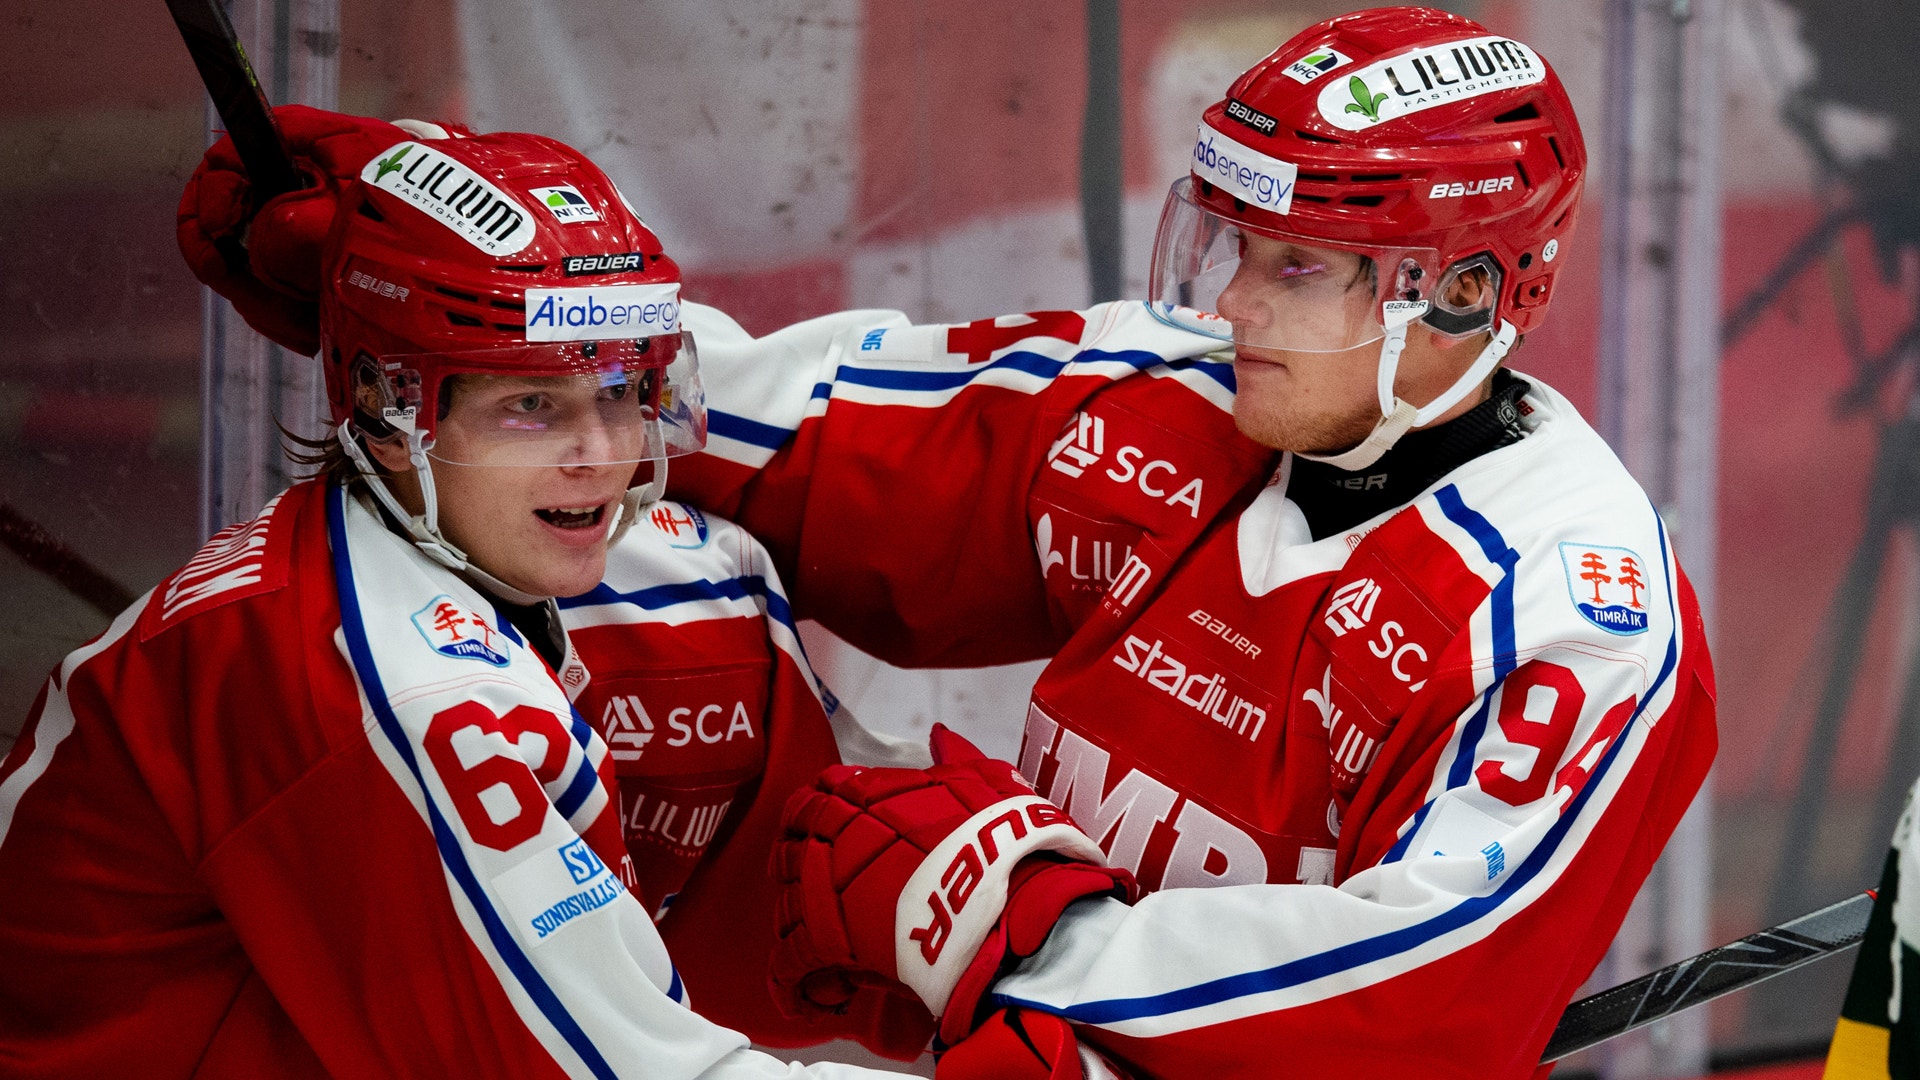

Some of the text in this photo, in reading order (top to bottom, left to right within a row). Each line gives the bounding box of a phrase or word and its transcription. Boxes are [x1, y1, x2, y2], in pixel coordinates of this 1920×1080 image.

[1291, 62, 1319, 81] NHC
[1385, 40, 1533, 97] LILIUM
[1403, 72, 1537, 108] FASTIGHETER
[1228, 100, 1277, 134] BAUER
[403, 153, 524, 242] LILIUM
[1429, 176, 1515, 200] BAUER
[395, 183, 497, 251] FASTIGHETER
[568, 255, 640, 272] BAUER
[348, 270, 411, 303] BAUER
[1386, 301, 1427, 310] BAUER
[385, 408, 415, 417] BAUER
[1105, 446, 1204, 519] SCA
[1188, 609, 1262, 661] BAUER
[1592, 607, 1643, 628] TIMRÅ IK
[1112, 634, 1267, 743] stadium
[666, 701, 755, 747] SCA
[909, 803, 1089, 966] AUER
